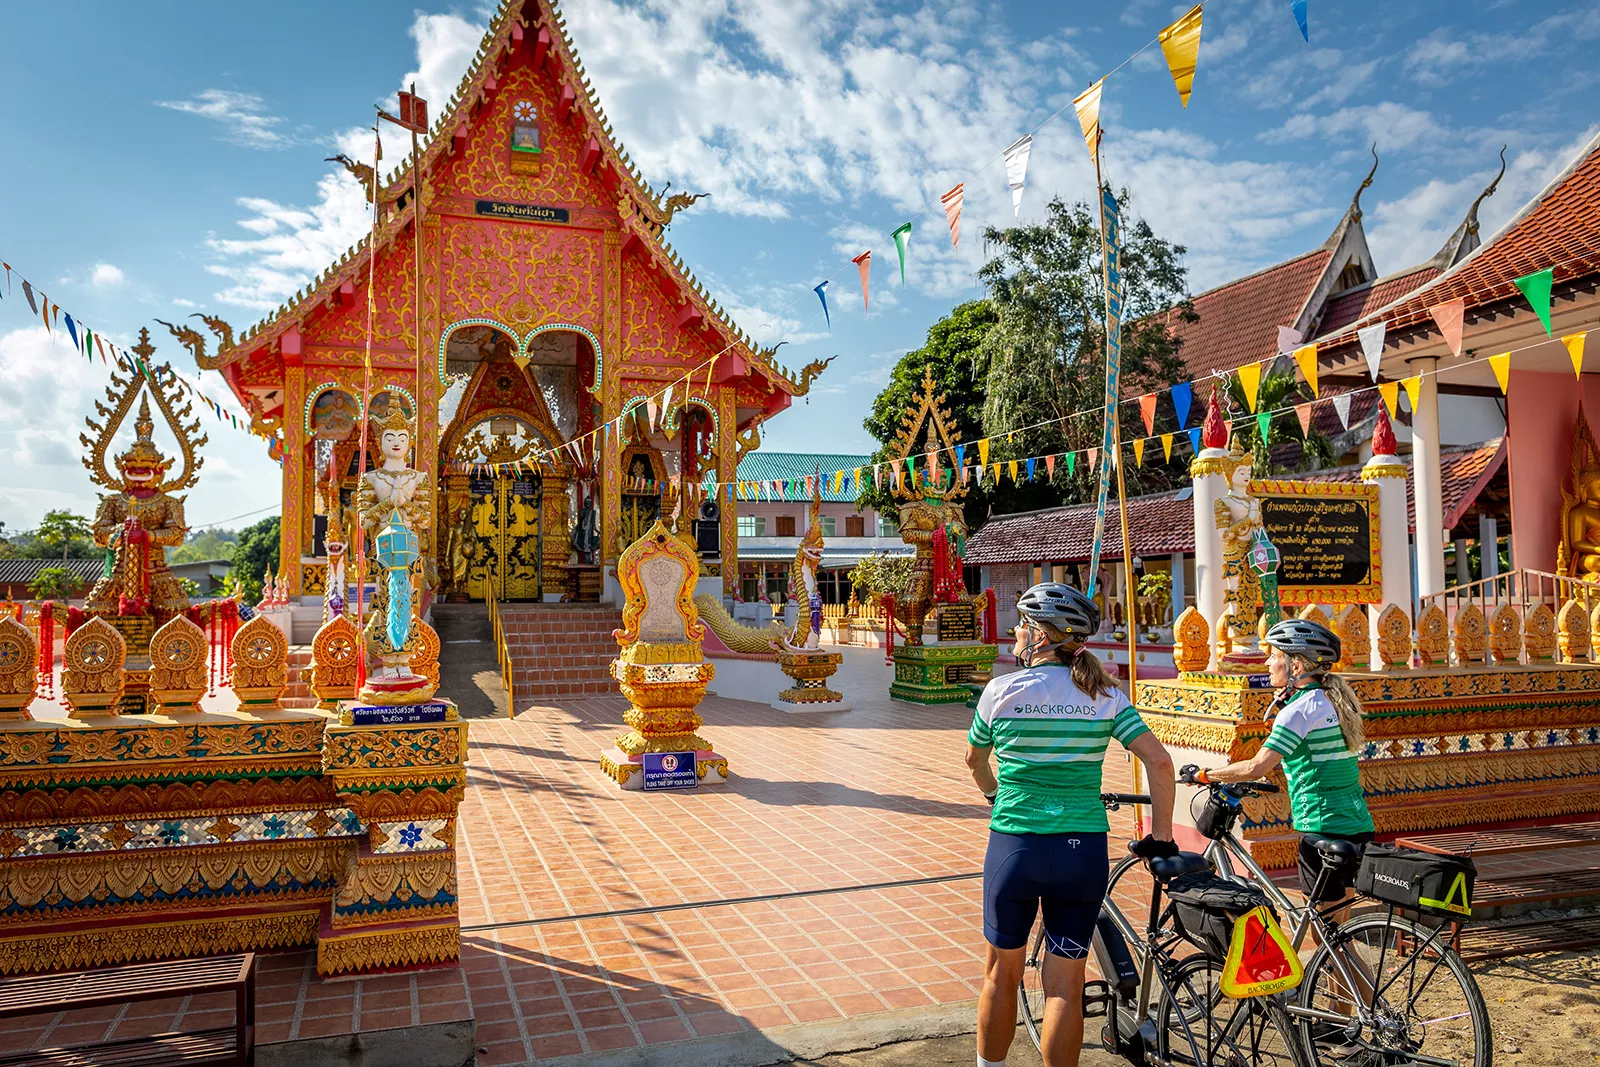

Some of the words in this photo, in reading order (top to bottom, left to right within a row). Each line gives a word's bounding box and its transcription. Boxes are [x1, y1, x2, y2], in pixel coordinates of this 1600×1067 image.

[1025, 704, 1097, 716] BACKROADS
[1375, 873, 1408, 889] BACKROADS
[1247, 980, 1285, 994] BACKROADS
